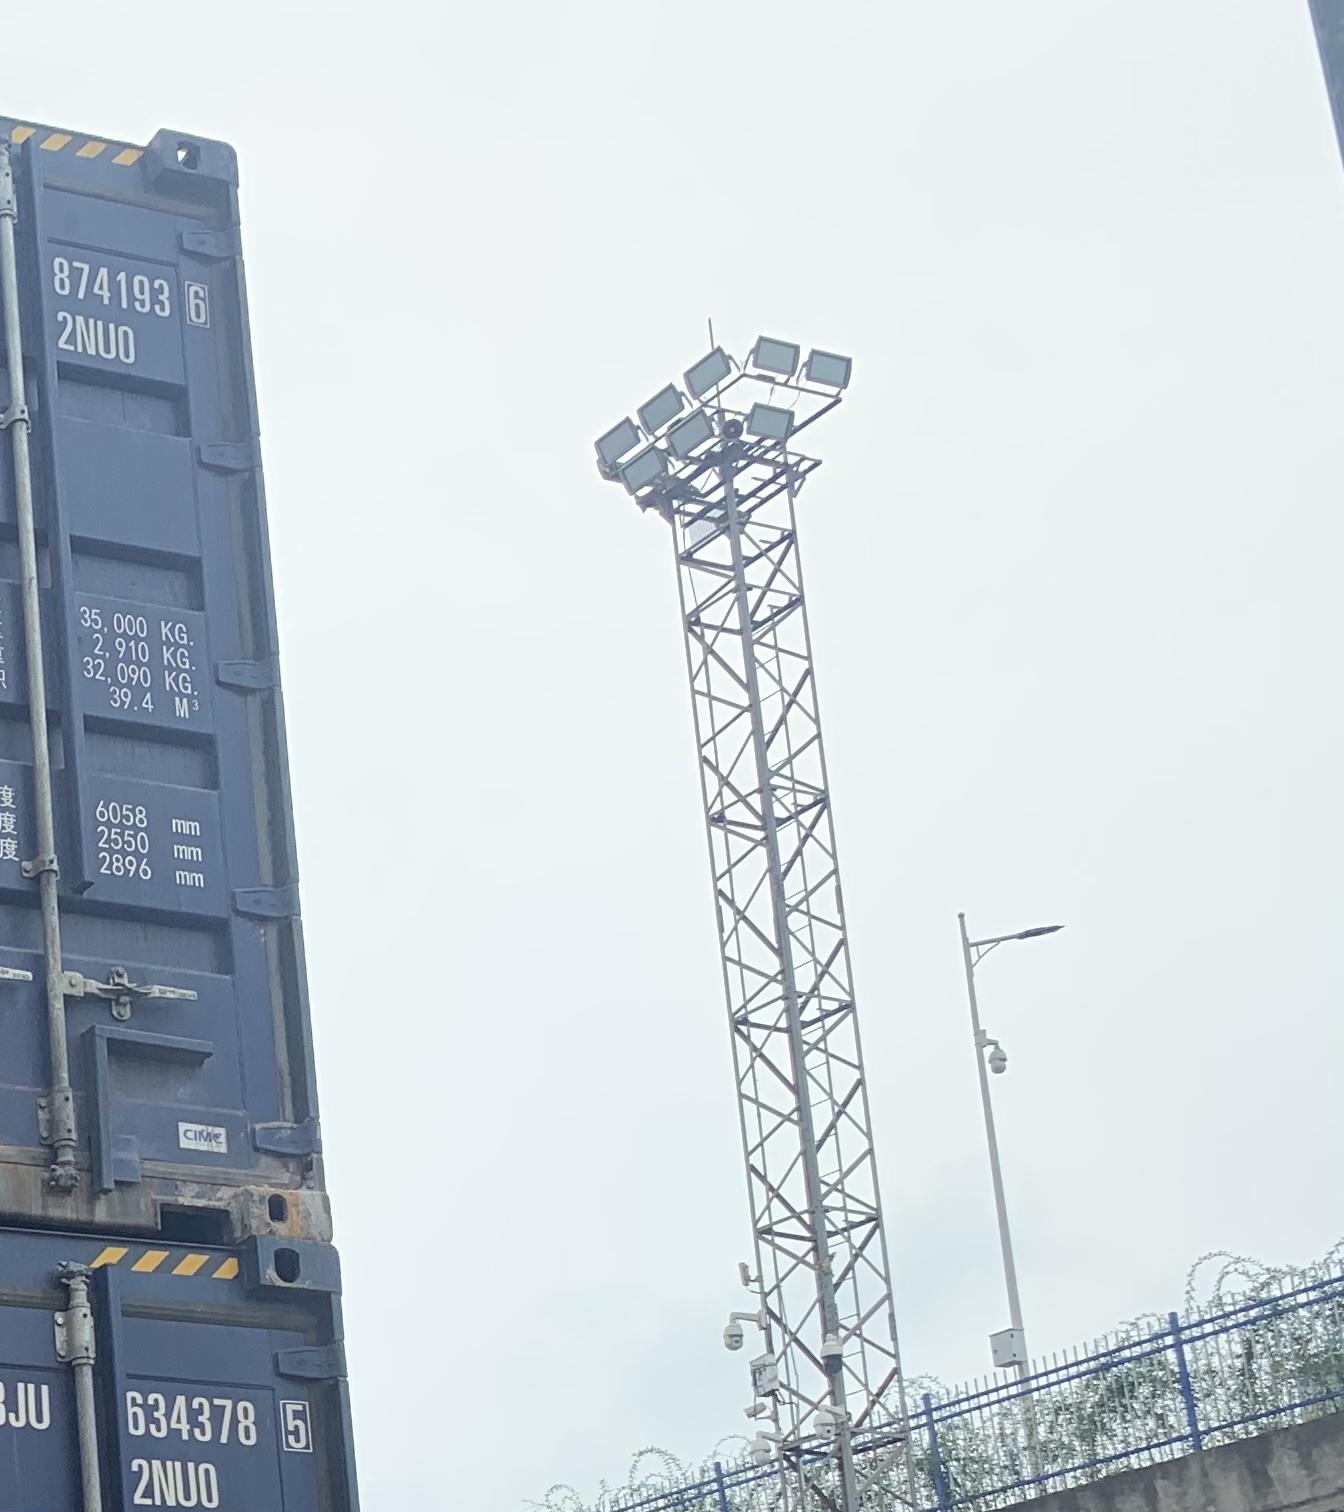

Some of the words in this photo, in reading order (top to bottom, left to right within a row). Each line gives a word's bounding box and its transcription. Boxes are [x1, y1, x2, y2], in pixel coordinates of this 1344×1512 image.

[53, 257, 171, 320] 874193
[188, 288, 206, 323] 6
[79, 606, 147, 638] 35,000
[160, 620, 194, 646] KG.
[92, 633, 149, 663] 2,910
[162, 645, 196, 671] KG.
[83, 656, 151, 688] 32,090
[164, 670, 198, 696] KG.
[109, 686, 154, 713] 39.4
[95, 800, 148, 828] 6058
[171, 818, 201, 836] mm
[96, 825, 149, 854] 2550
[173, 844, 202, 862] mm
[98, 851, 152, 880] 2896
[175, 870, 204, 888] mm
[126, 1390, 257, 1446] 634378
[286, 1405, 306, 1447] 5
